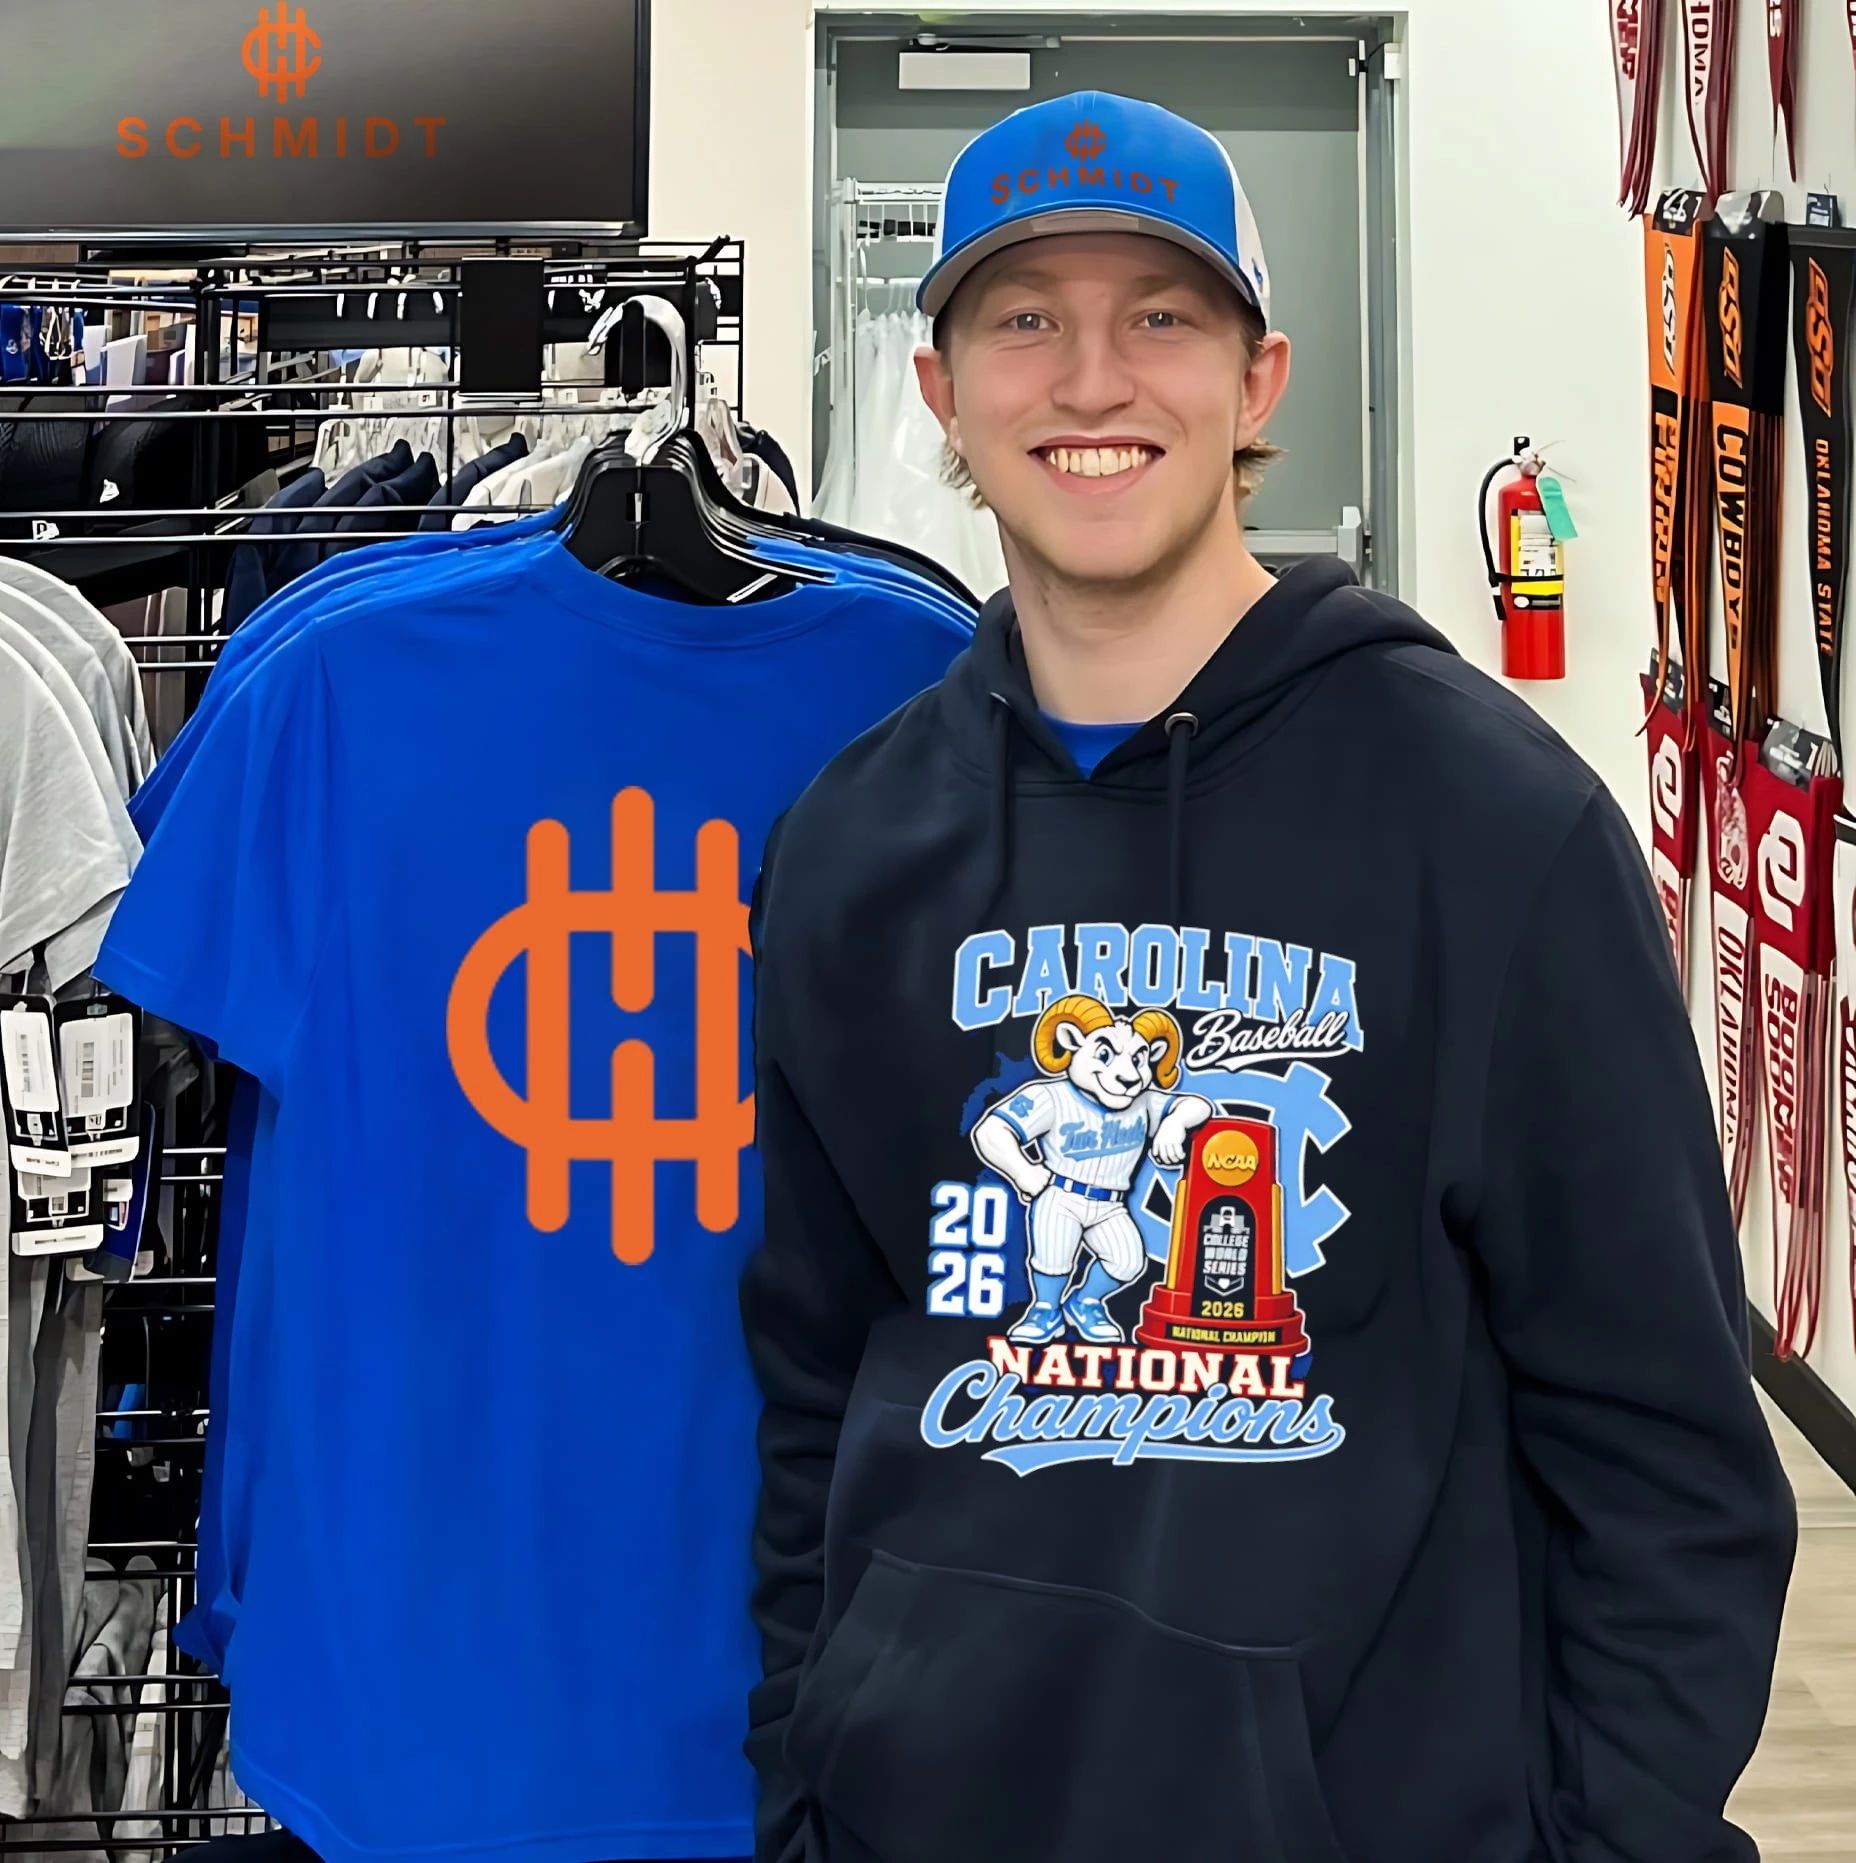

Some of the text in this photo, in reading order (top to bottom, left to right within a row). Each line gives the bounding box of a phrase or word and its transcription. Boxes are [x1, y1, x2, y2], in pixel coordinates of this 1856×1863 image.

[116, 116, 448, 158] SCHMIDT
[991, 166, 1181, 205] SCHMIDT
[1814, 438, 1833, 570] OKLAHOMA
[952, 922, 1365, 1053] CAROLINA
[1187, 1009, 1352, 1073] Baseball
[930, 1183, 1009, 1249] 20
[1203, 1233, 1250, 1248] COLLEGE
[928, 1251, 1007, 1317] 26
[1203, 1260, 1247, 1276] SERIES
[1201, 1300, 1245, 1318] 2026
[987, 1336, 1306, 1399] NATIONAL
[920, 1359, 1346, 1478] Champions
